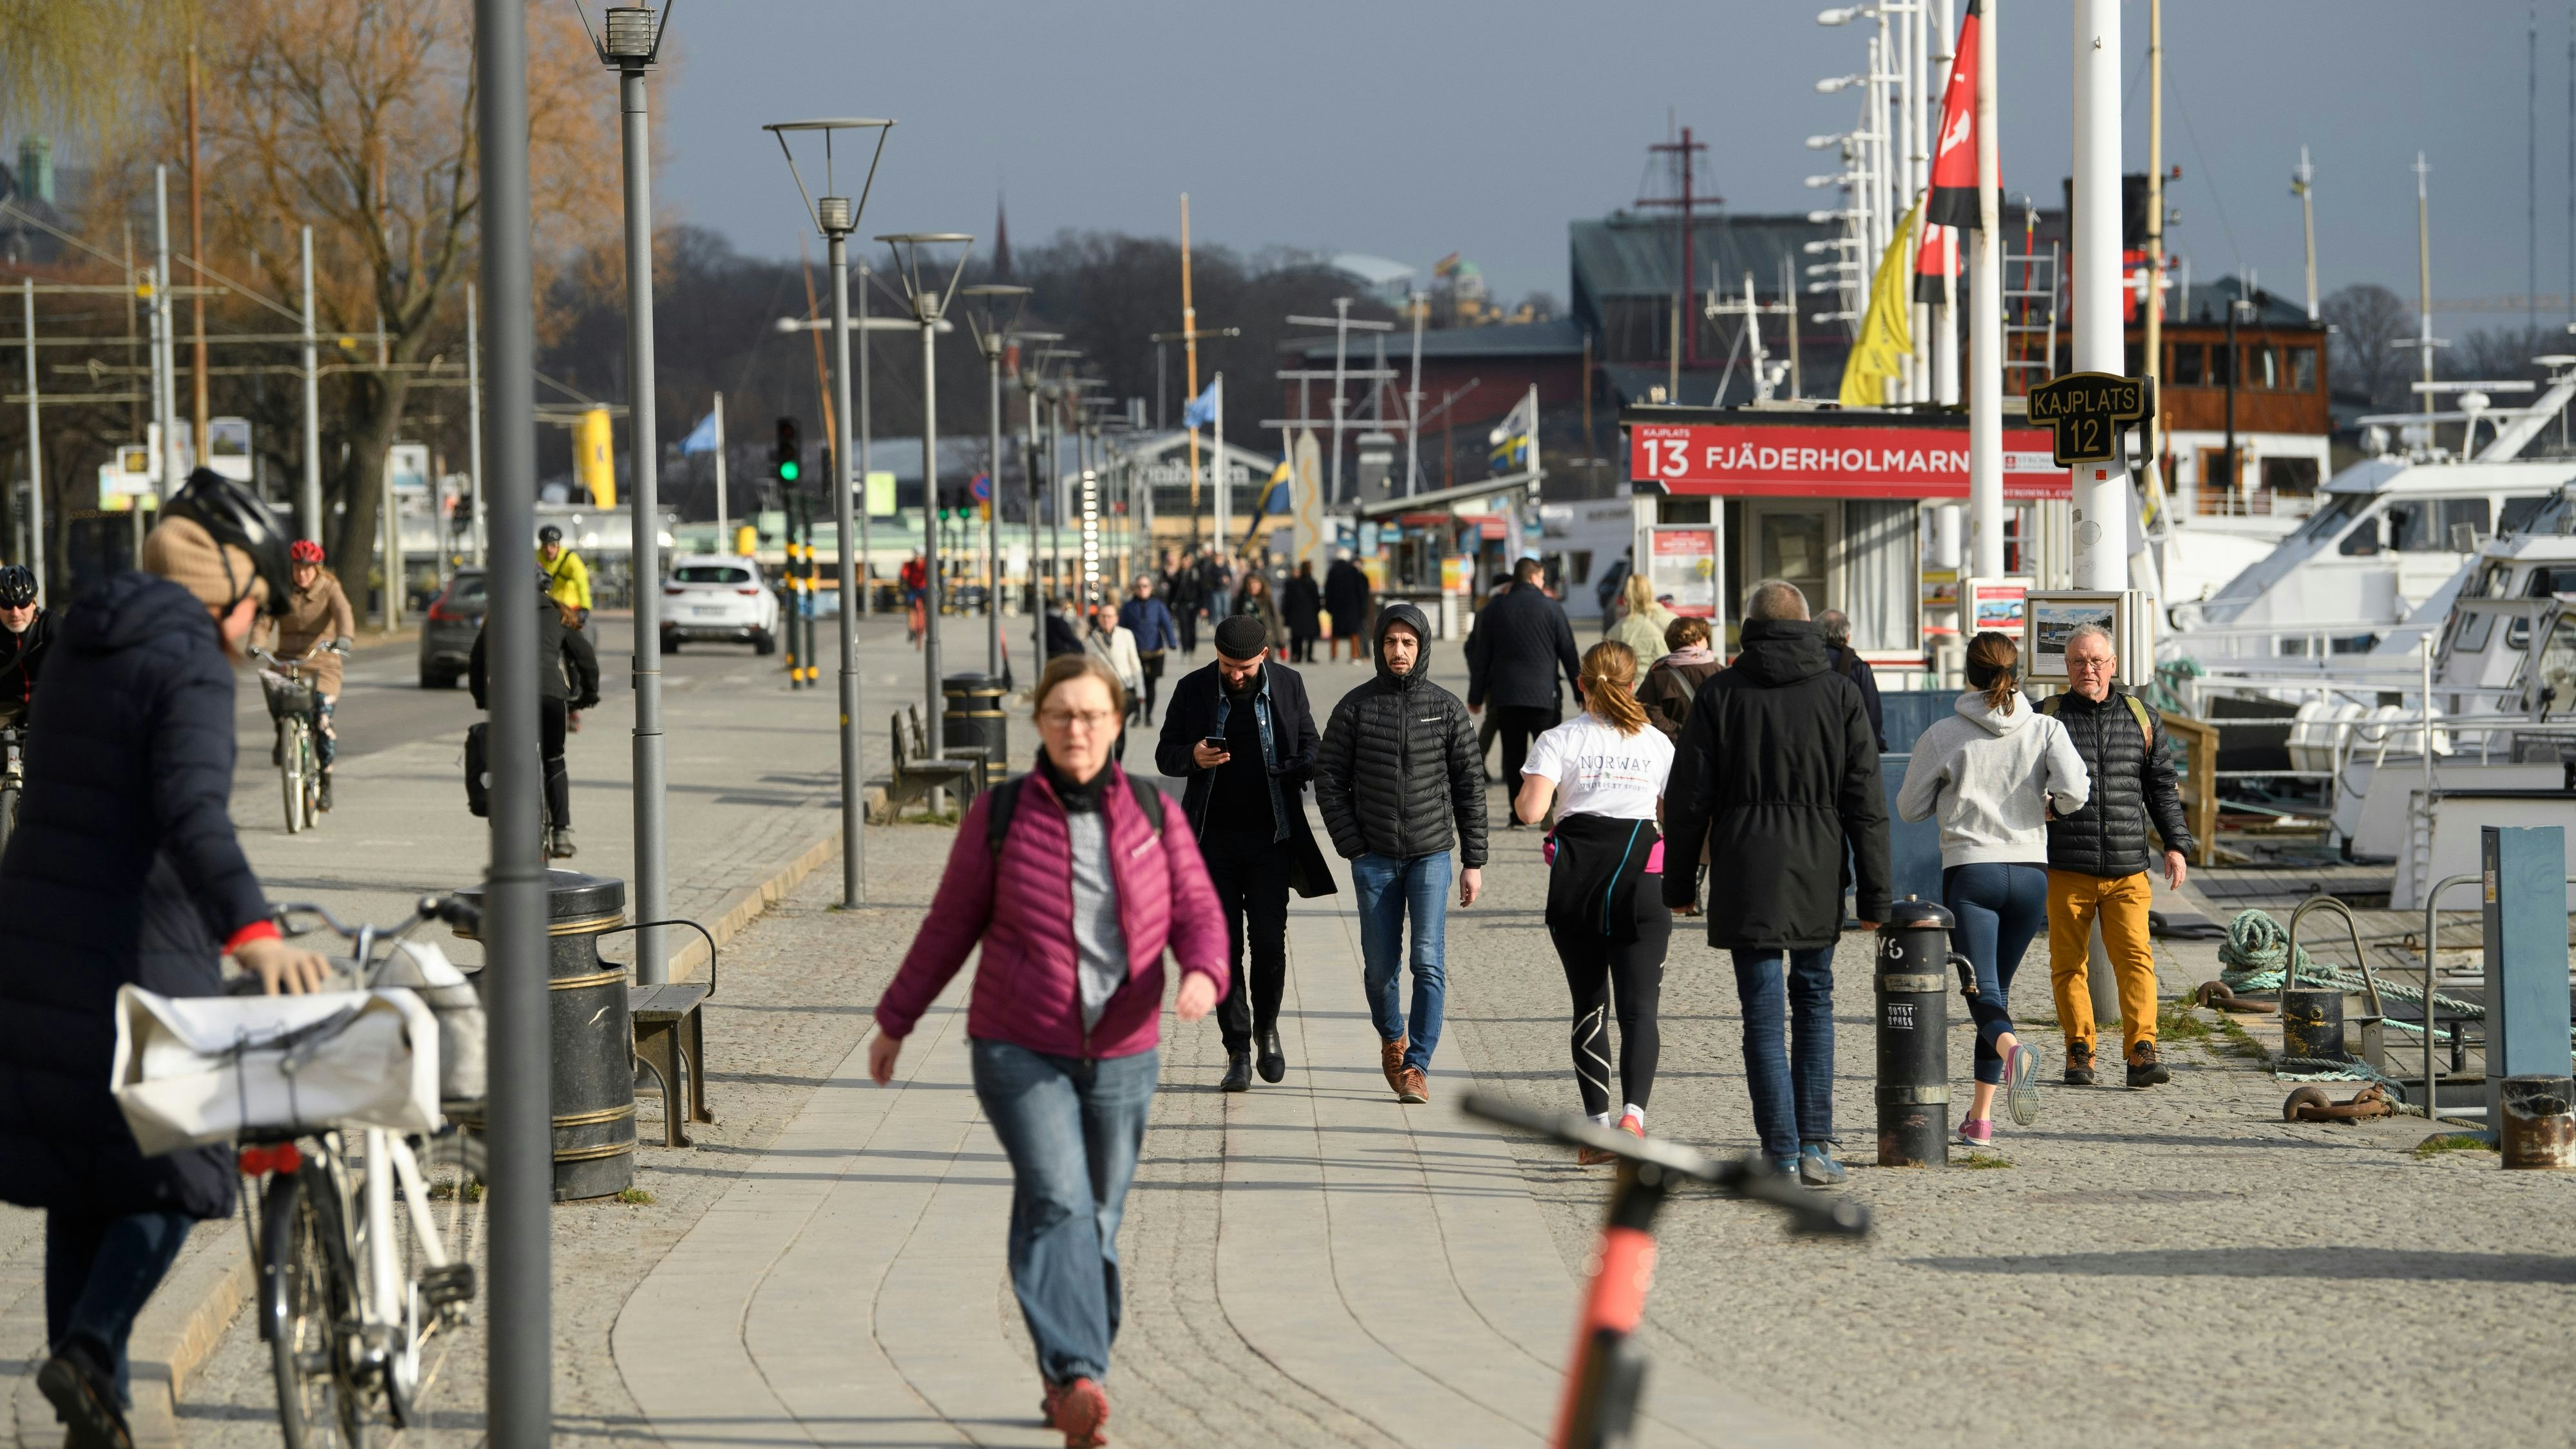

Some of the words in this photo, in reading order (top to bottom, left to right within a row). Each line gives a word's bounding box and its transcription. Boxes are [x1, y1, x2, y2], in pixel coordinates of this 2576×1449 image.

[2035, 388, 2135, 416] KAJPLATS
[1643, 428, 1690, 437] KAJPLATS
[2071, 419, 2099, 452] 12
[1642, 439, 1689, 477] 13
[1706, 442, 1970, 473] FJÄDERHOLMARN
[1581, 755, 1651, 772] NORWAY
